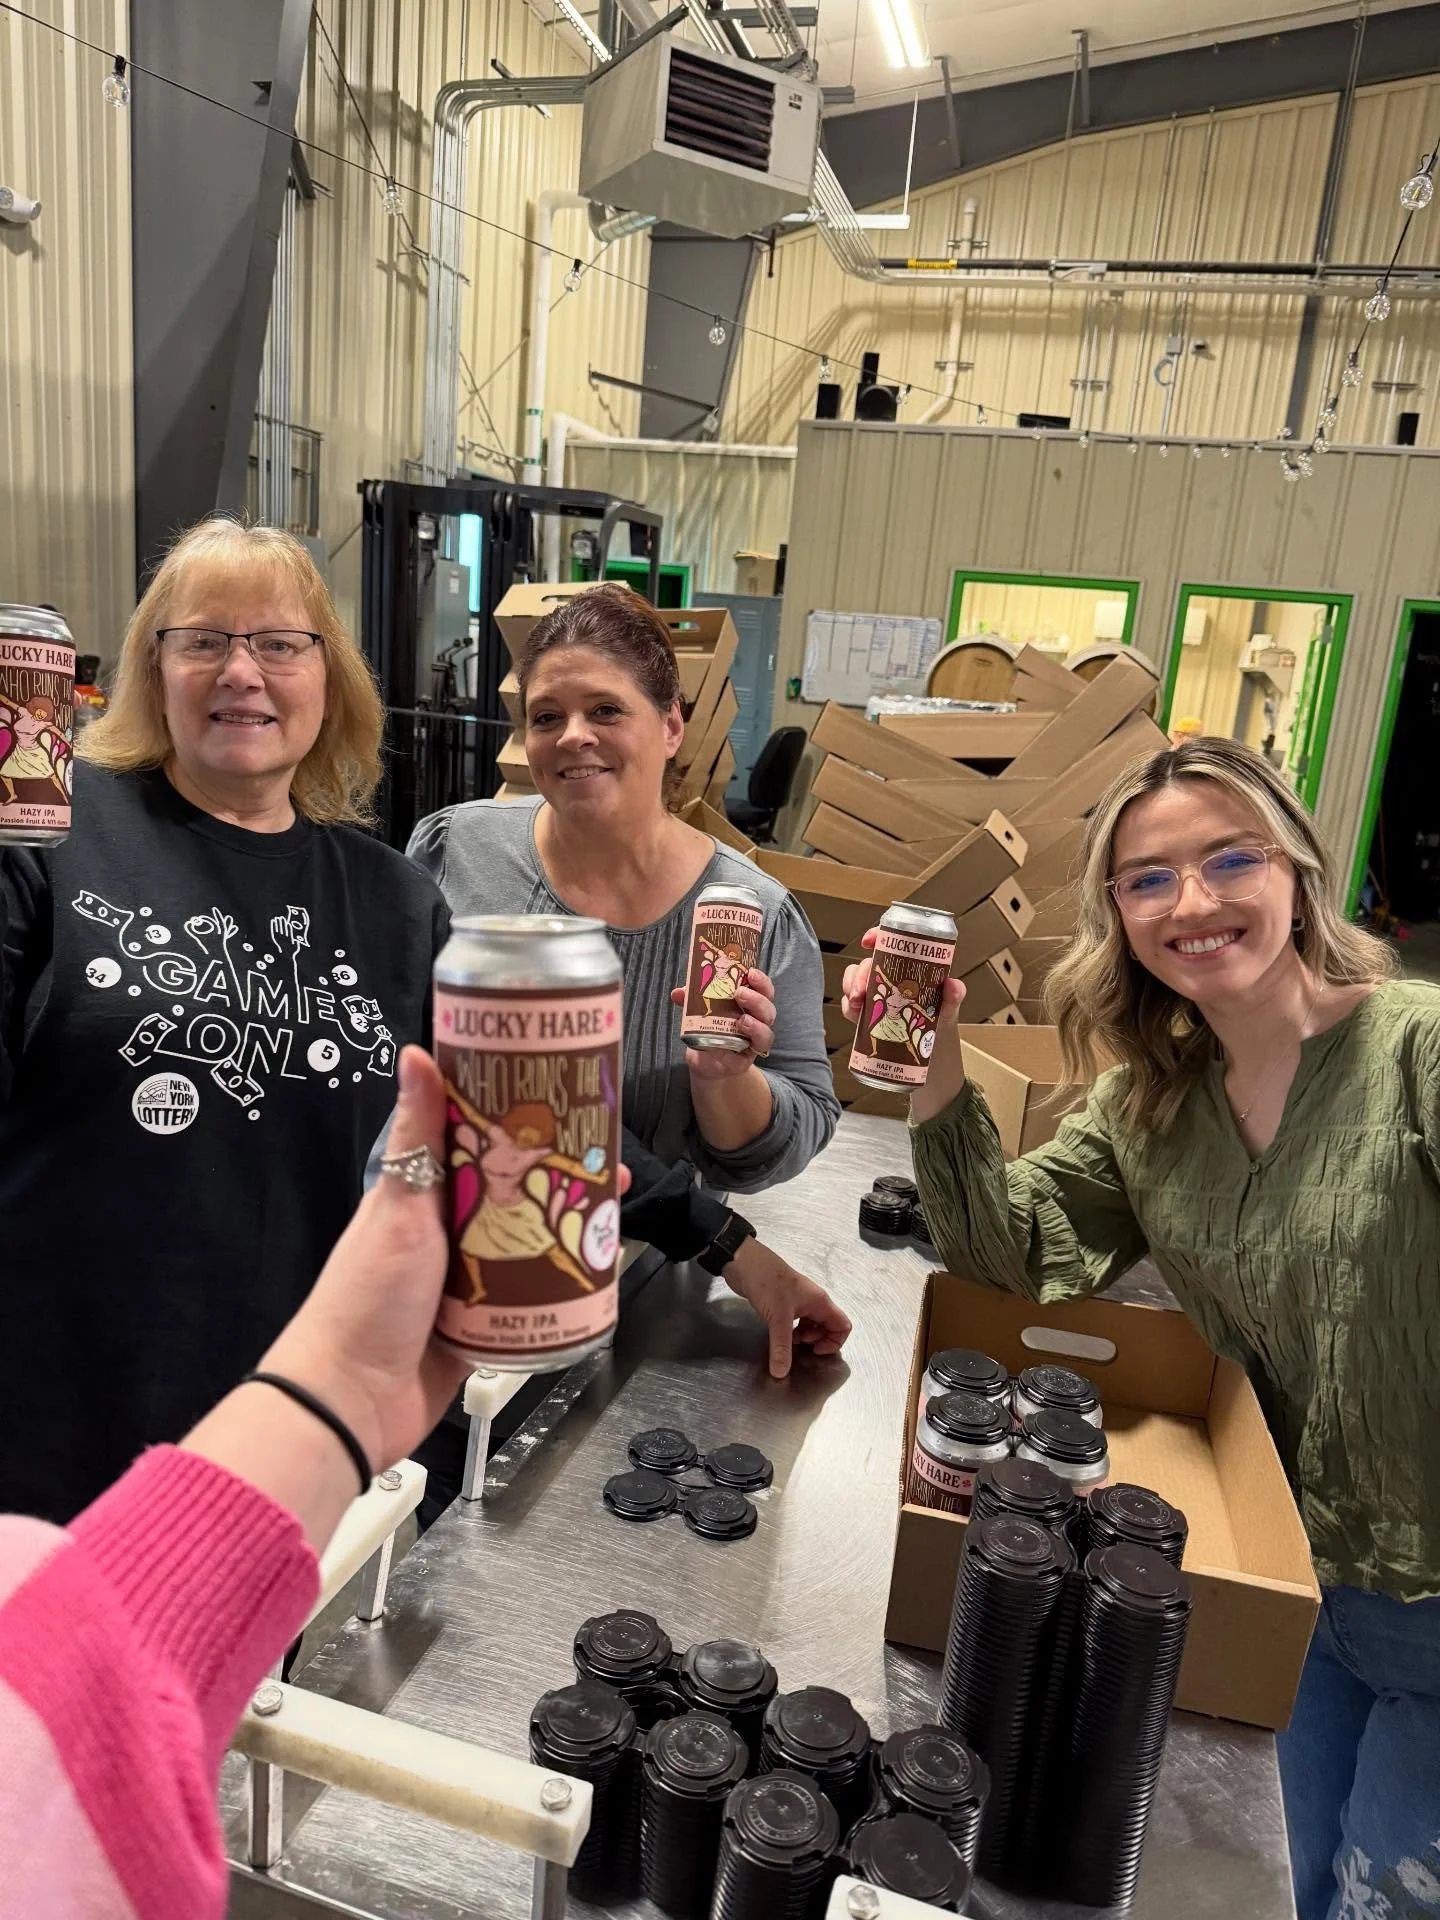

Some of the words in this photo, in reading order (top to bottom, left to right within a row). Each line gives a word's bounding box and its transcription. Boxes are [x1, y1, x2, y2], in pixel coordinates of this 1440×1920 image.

[0, 645, 42, 662] UCKY
[46, 650, 73, 668] HARE
[34, 671, 60, 706] RUNS
[20, 807, 41, 817] HAZY
[44, 809, 56, 818] IPA
[707, 909, 738, 921] LUCKY
[739, 912, 759, 926] HARE
[885, 937, 919, 953] LUCKY
[920, 944, 948, 959] HARE
[86, 967, 107, 983] 34
[143, 952, 336, 1024] GAME
[453, 1008, 531, 1038] LUCKY
[538, 1008, 604, 1038] HARE
[186, 1013, 307, 1080] ON
[321, 1045, 334, 1060] 5
[876, 1062, 891, 1071] HAZY
[893, 1066, 904, 1074] IPA
[170, 1080, 190, 1092] NEW
[456, 1050, 509, 1117] WHO
[513, 1055, 568, 1118] RUNS
[170, 1092, 195, 1106] YORK
[138, 1106, 195, 1126] LOTTERY
[489, 1315, 528, 1329] HAZY
[532, 1313, 558, 1328] IPA
[926, 1463, 960, 1488] HARE
